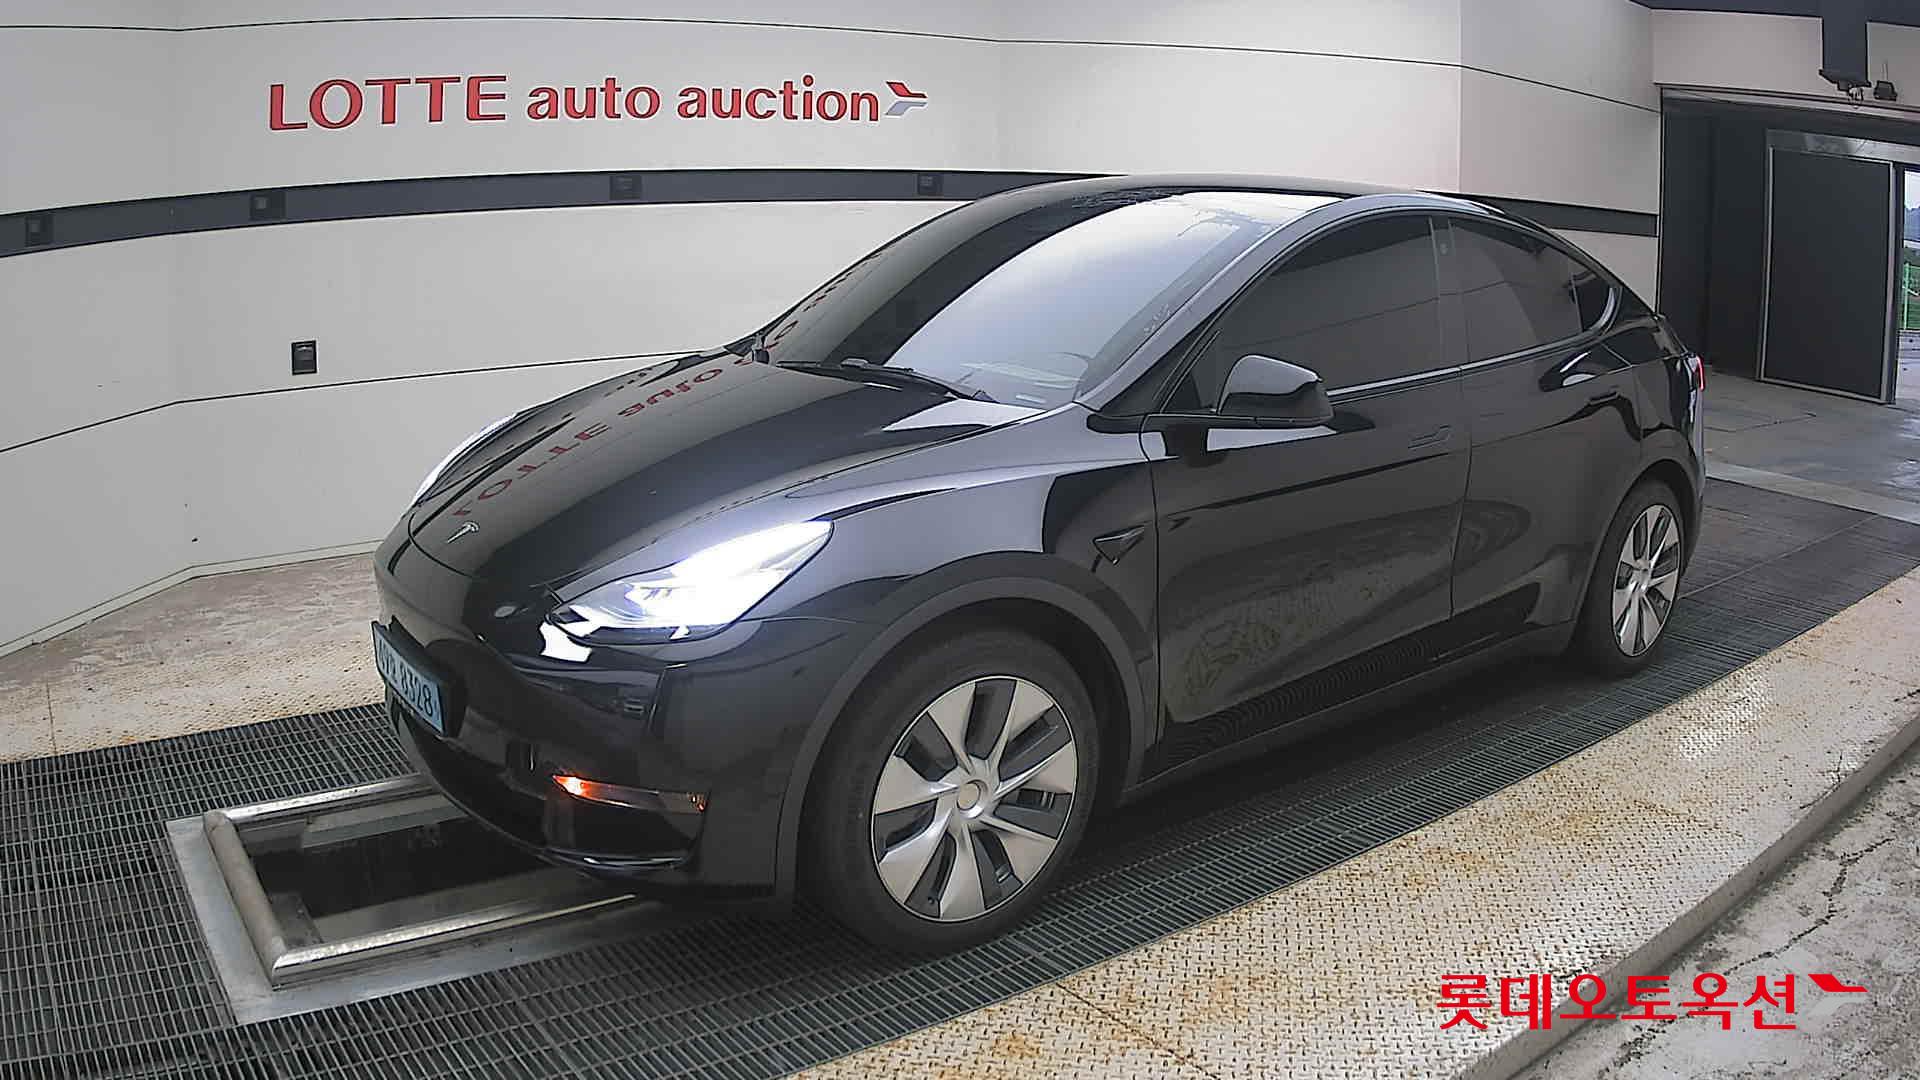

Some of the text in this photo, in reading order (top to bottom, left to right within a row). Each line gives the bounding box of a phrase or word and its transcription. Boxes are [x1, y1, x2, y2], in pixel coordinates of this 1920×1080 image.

[270, 75, 881, 131] LOTTE auto auction
